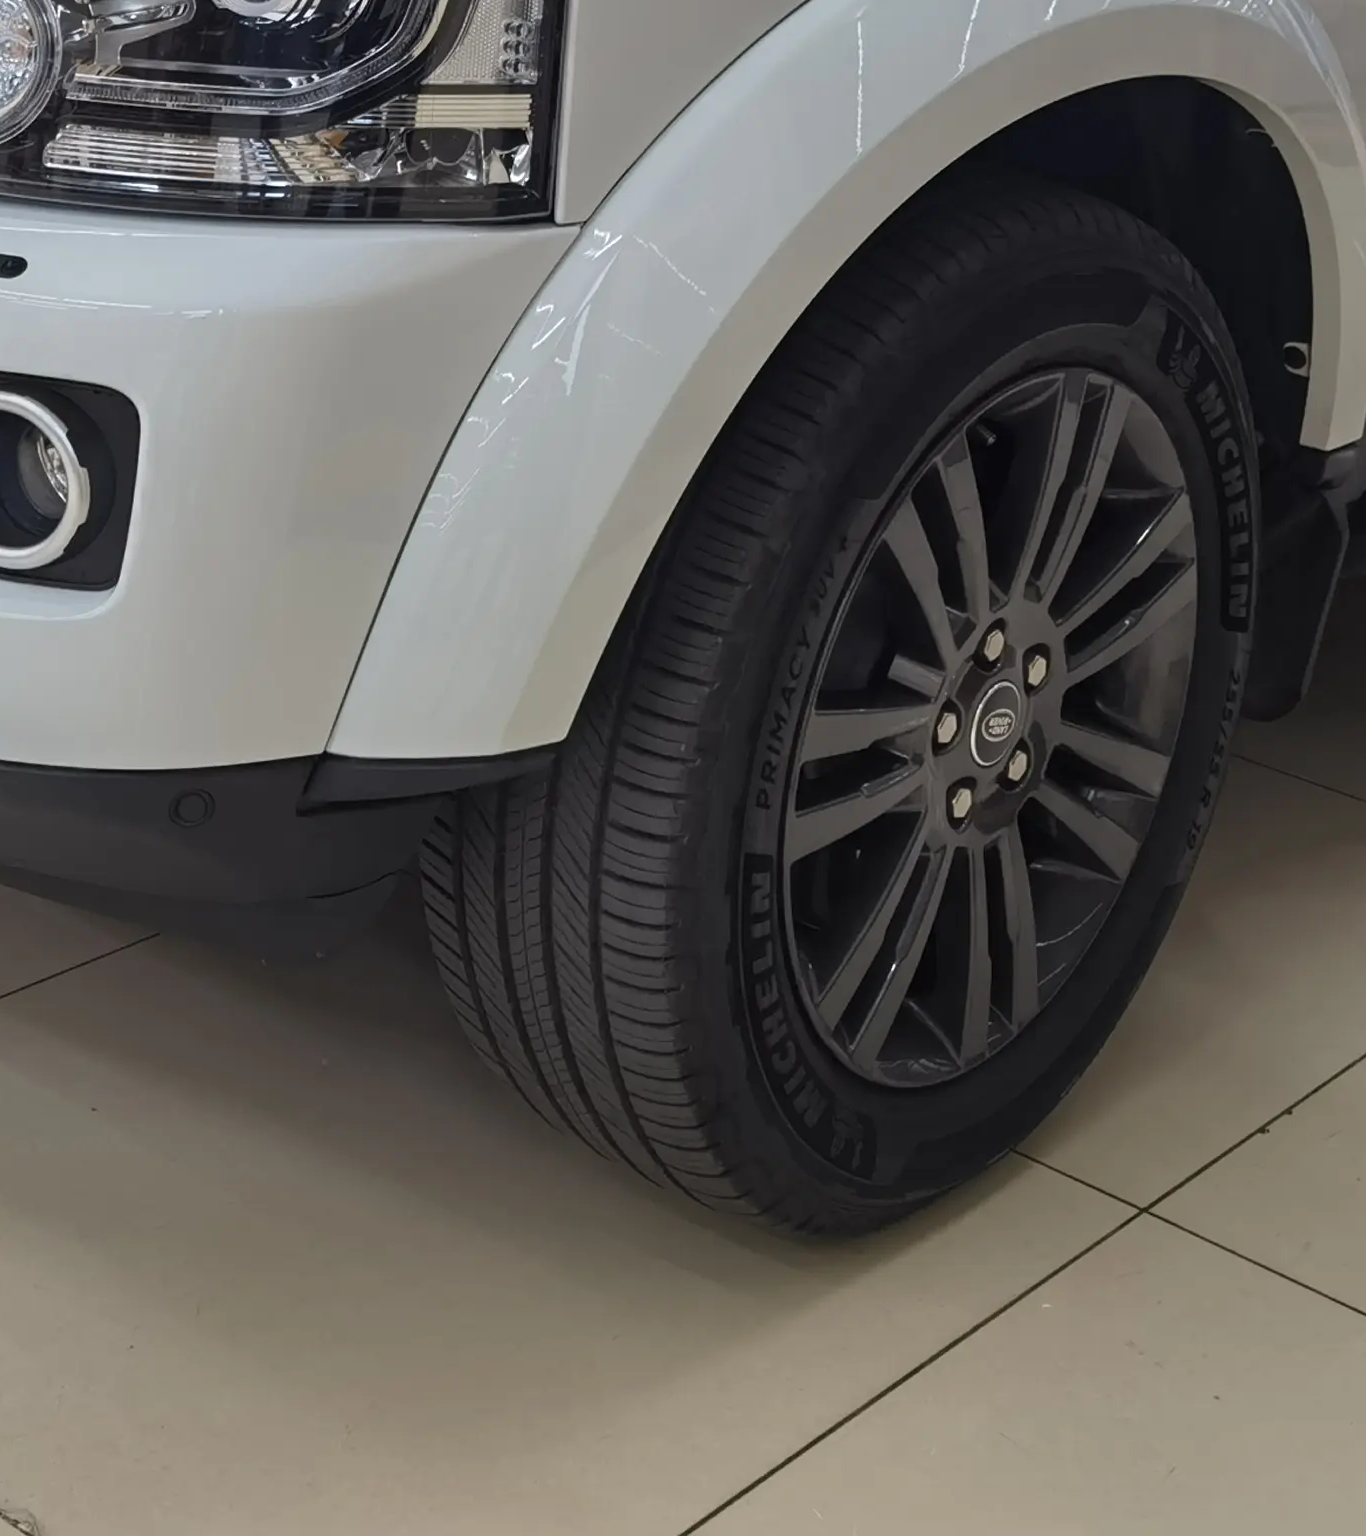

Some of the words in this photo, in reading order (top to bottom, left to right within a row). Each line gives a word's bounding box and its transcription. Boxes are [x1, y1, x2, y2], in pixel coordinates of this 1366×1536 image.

[1195, 380, 1250, 618] MICHELIN
[755, 625, 811, 811] PRIMACY
[750, 871, 828, 1129] MICHELIN
